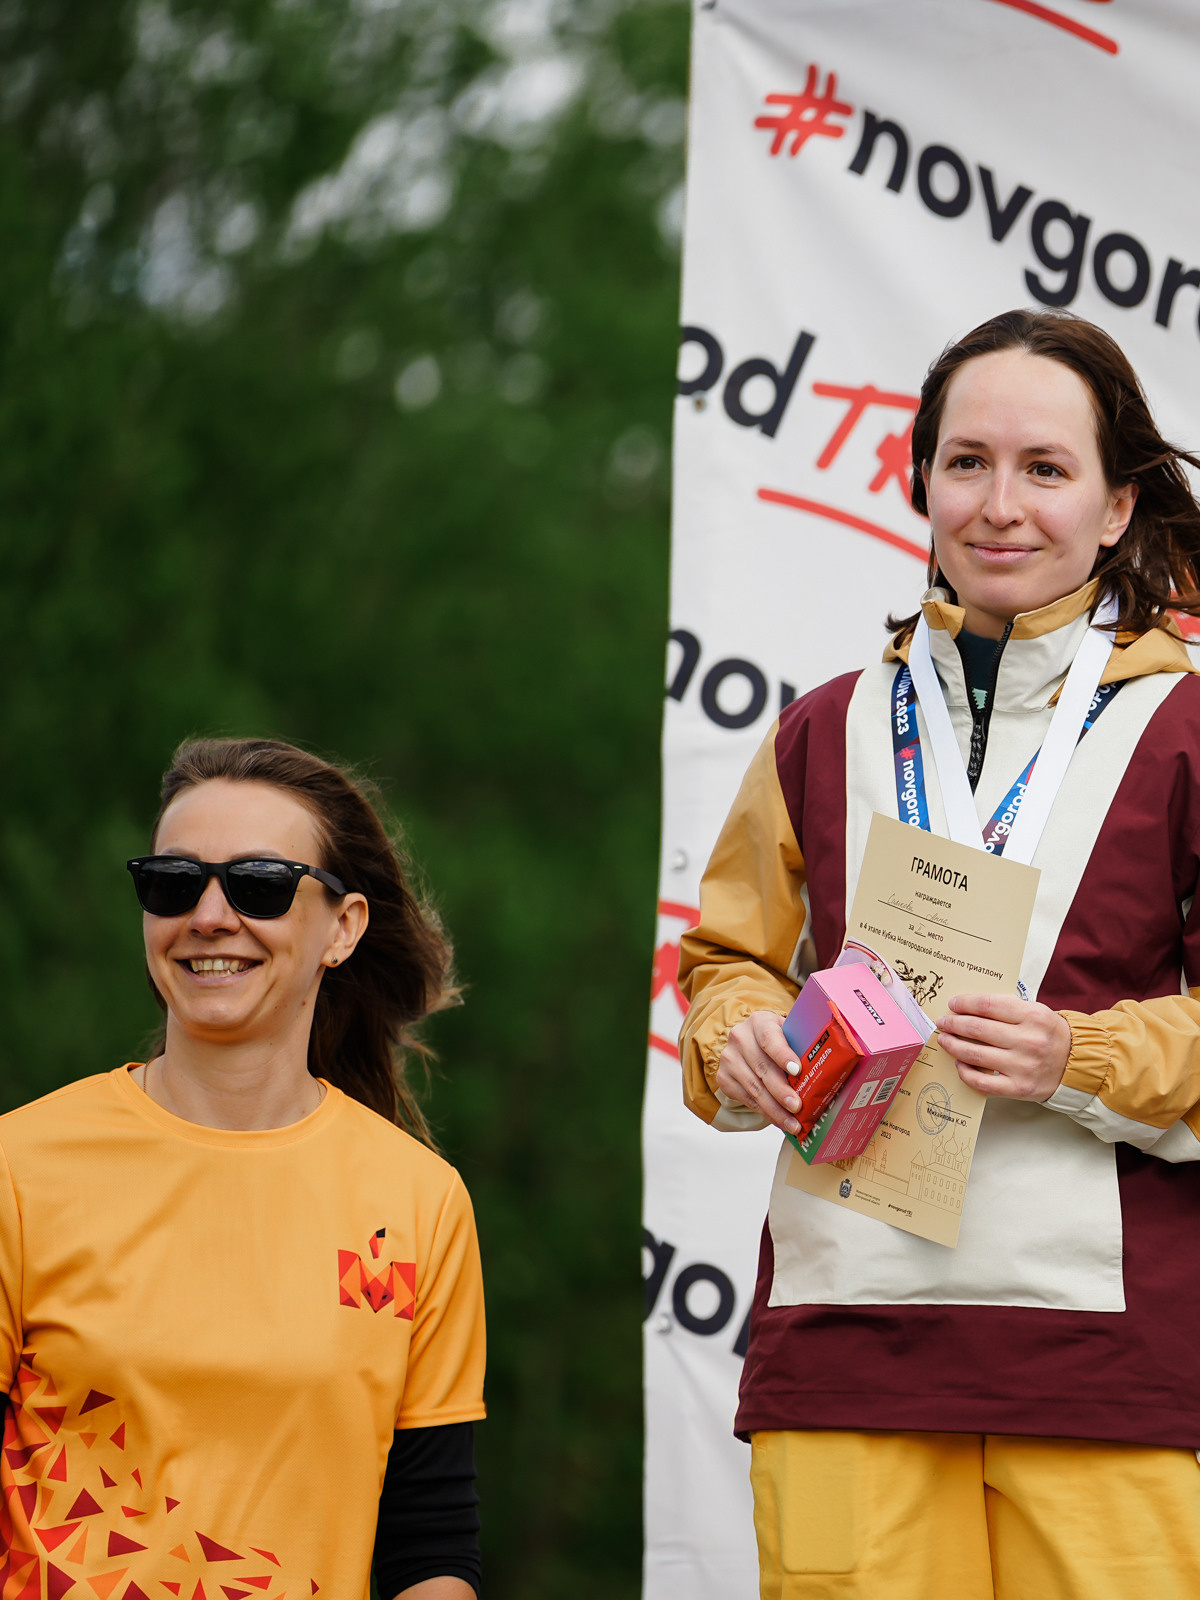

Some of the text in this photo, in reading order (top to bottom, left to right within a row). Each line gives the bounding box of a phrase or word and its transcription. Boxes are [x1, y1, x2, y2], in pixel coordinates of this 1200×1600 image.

[896, 697, 910, 736] 2023
[900, 746, 923, 830] #novgoro
[911, 856, 969, 892] ГРАМОТА
[914, 890, 952, 909] награждается
[908, 923, 915, 931] за
[927, 931, 944, 942] место
[868, 925, 882, 936] этапе
[882, 928, 897, 942] Кубка
[896, 935, 933, 957] Новгородской
[933, 949, 956, 965] области
[957, 959, 965, 968] по
[966, 961, 1004, 981] триатлону
[880, 1130, 892, 1140] 2023
[888, 1123, 911, 1137] Новгород
